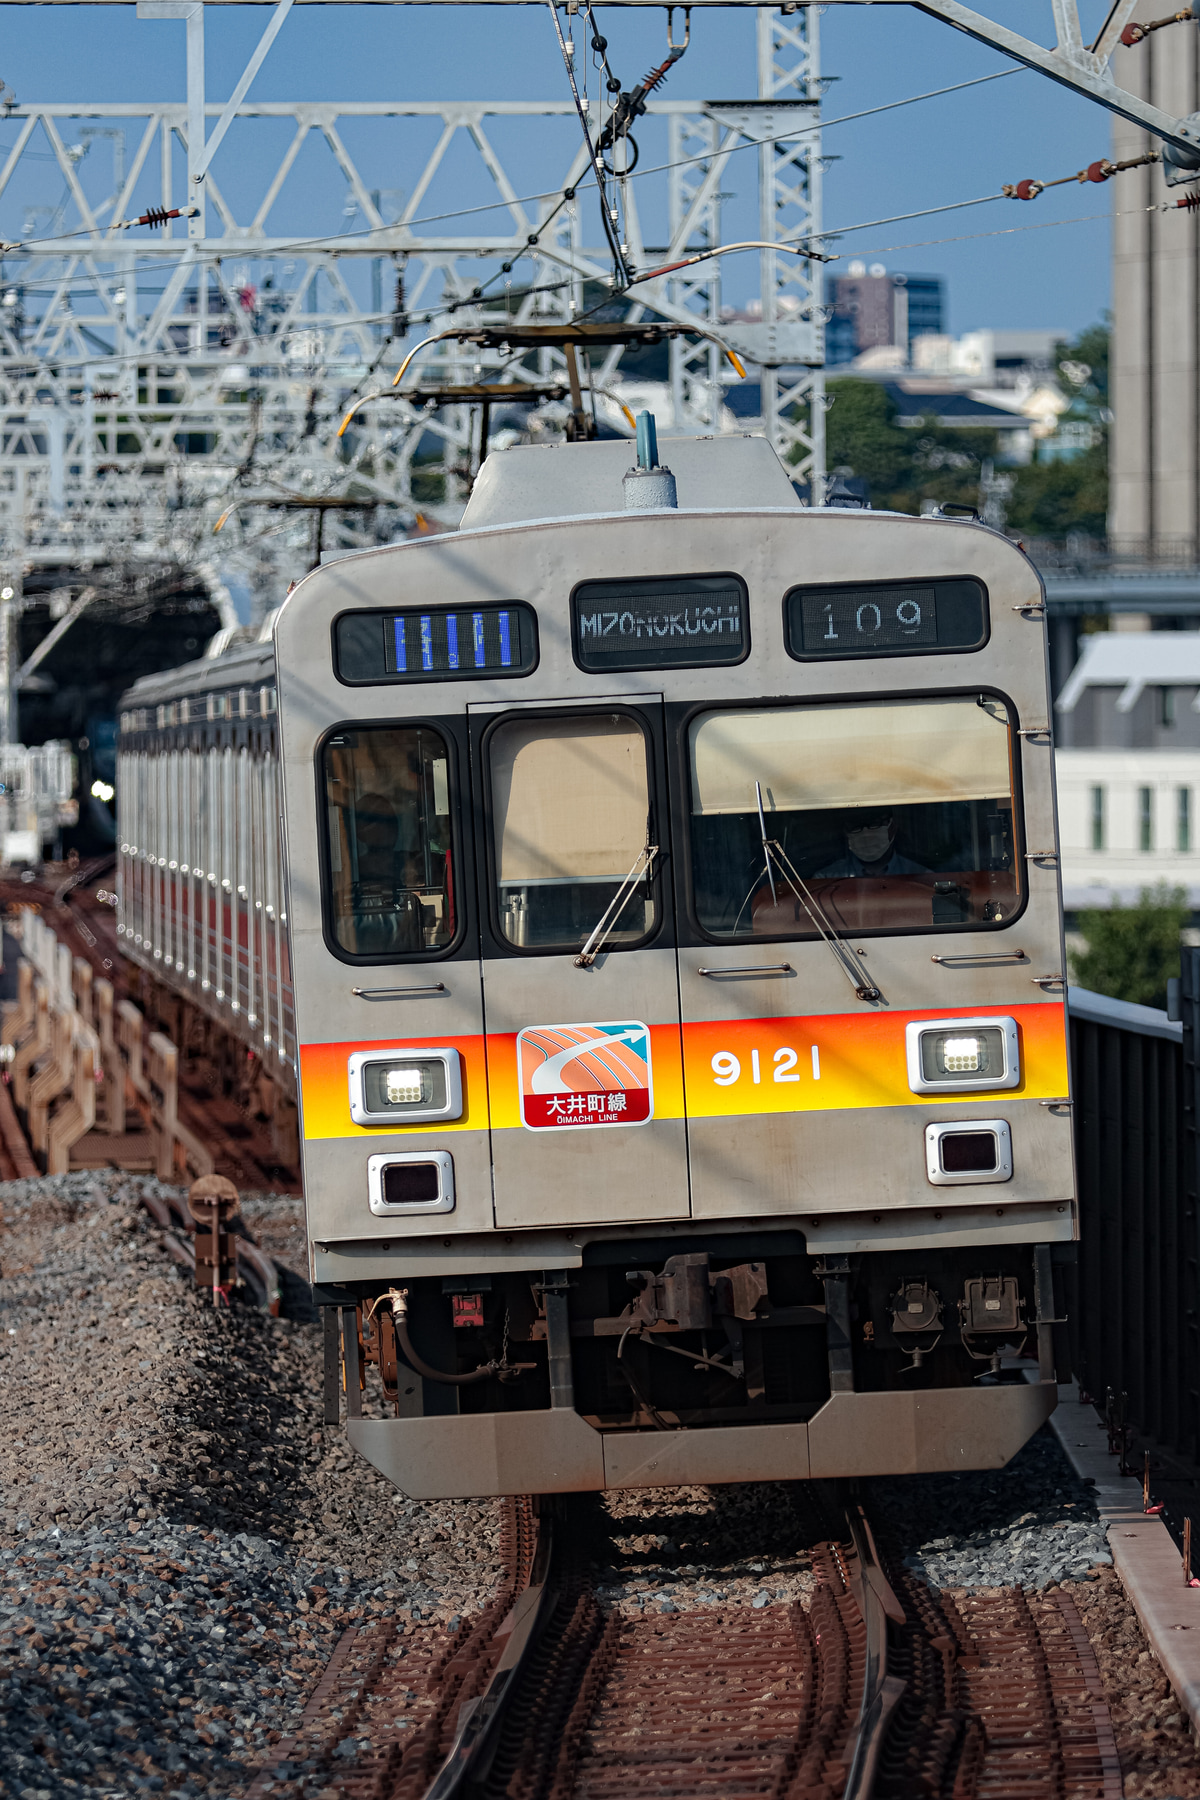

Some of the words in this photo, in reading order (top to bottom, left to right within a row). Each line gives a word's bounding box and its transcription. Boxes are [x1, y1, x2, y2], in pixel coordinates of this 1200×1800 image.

[823, 599, 921, 639] 109
[711, 1045, 820, 1086] 9121
[546, 1092, 627, 1116] 大井町線
[598, 1113, 618, 1122] LINE
